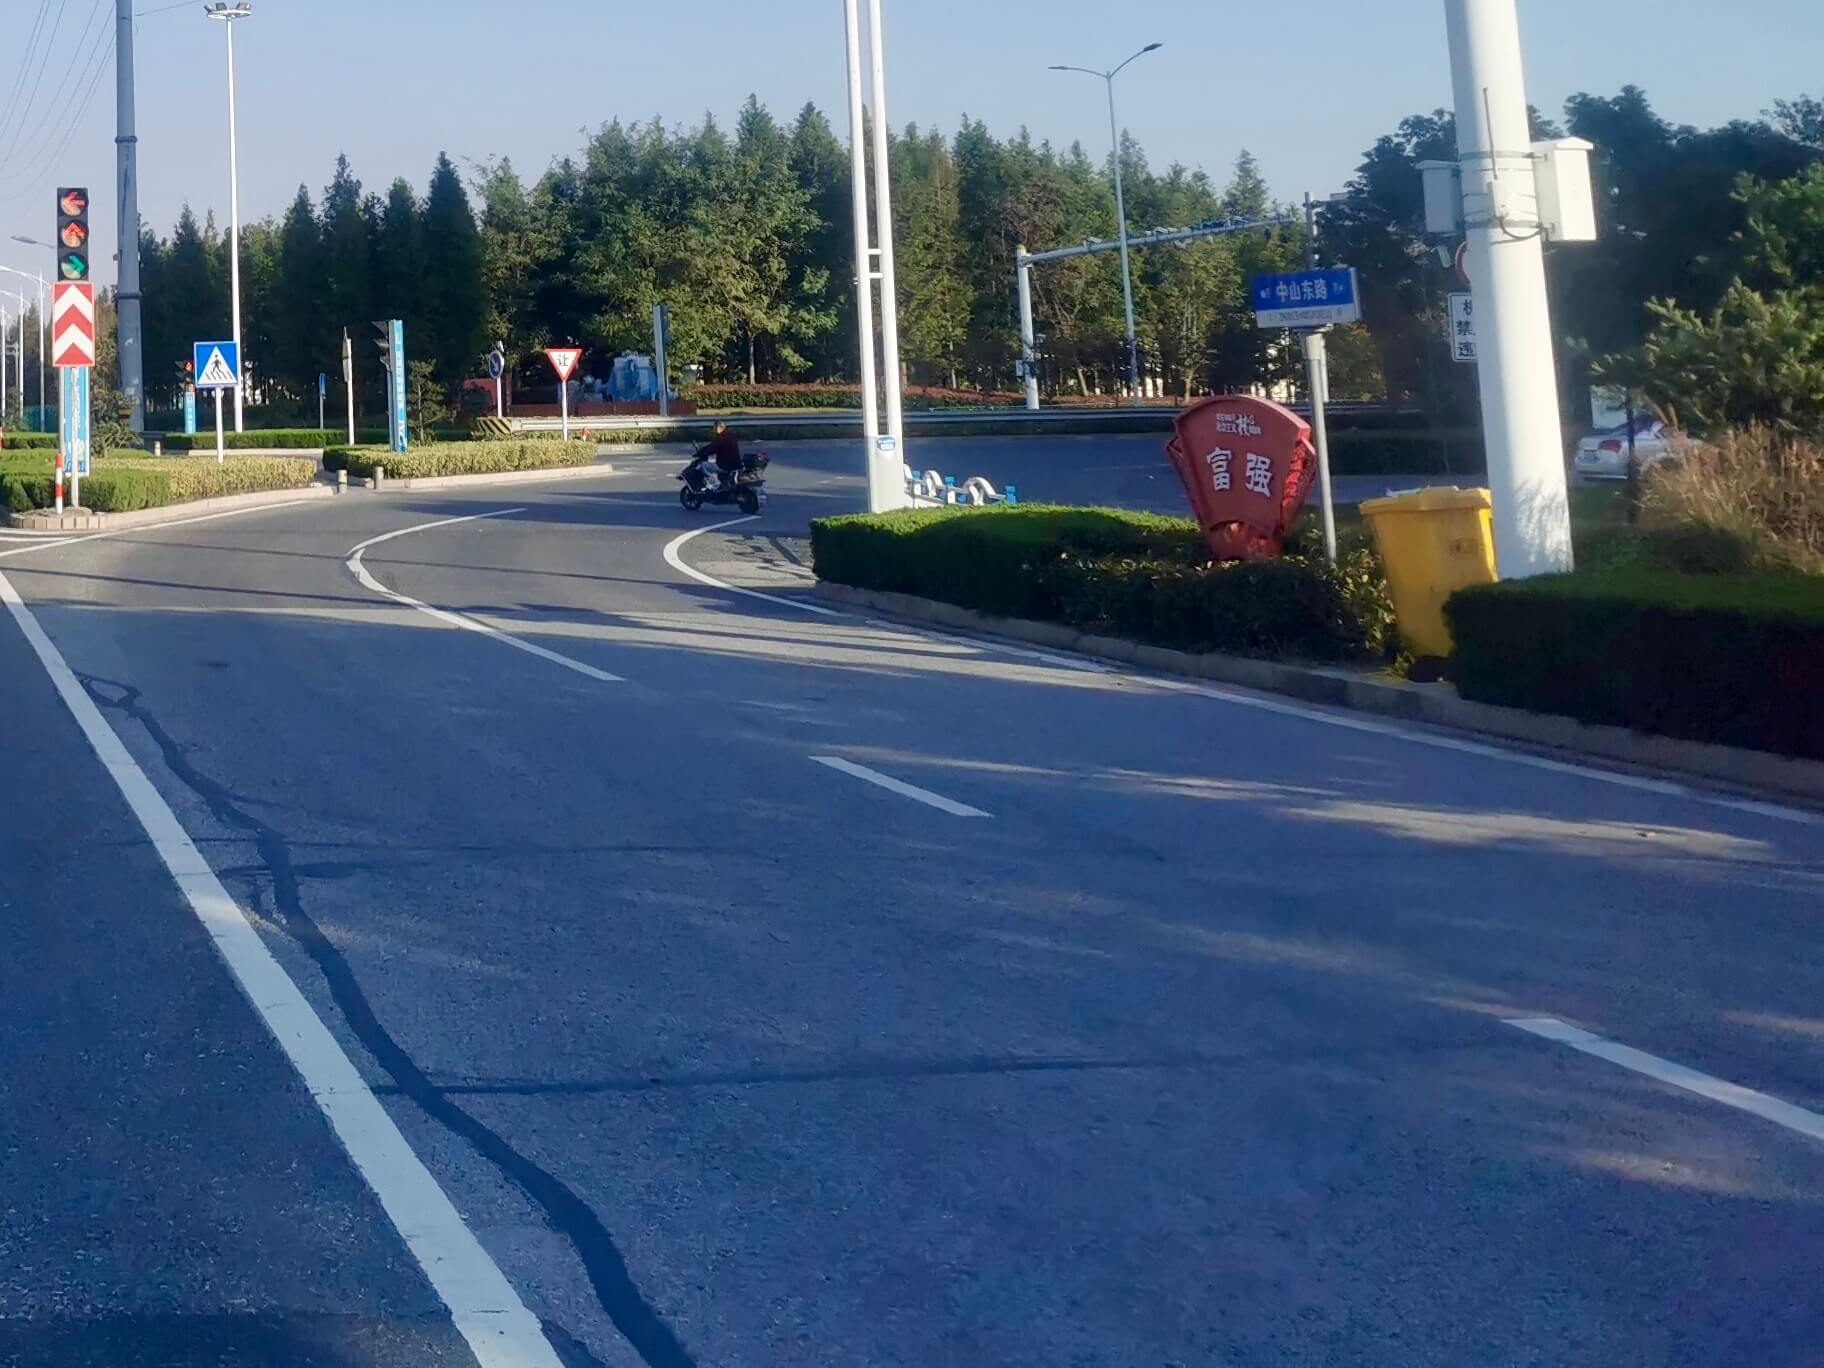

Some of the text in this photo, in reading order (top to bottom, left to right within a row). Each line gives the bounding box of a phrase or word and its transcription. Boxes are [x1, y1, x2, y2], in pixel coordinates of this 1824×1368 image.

[1276, 278, 1328, 303] 中山东路
[557, 353, 568, 366] 让
[1206, 447, 1272, 497] 富强
